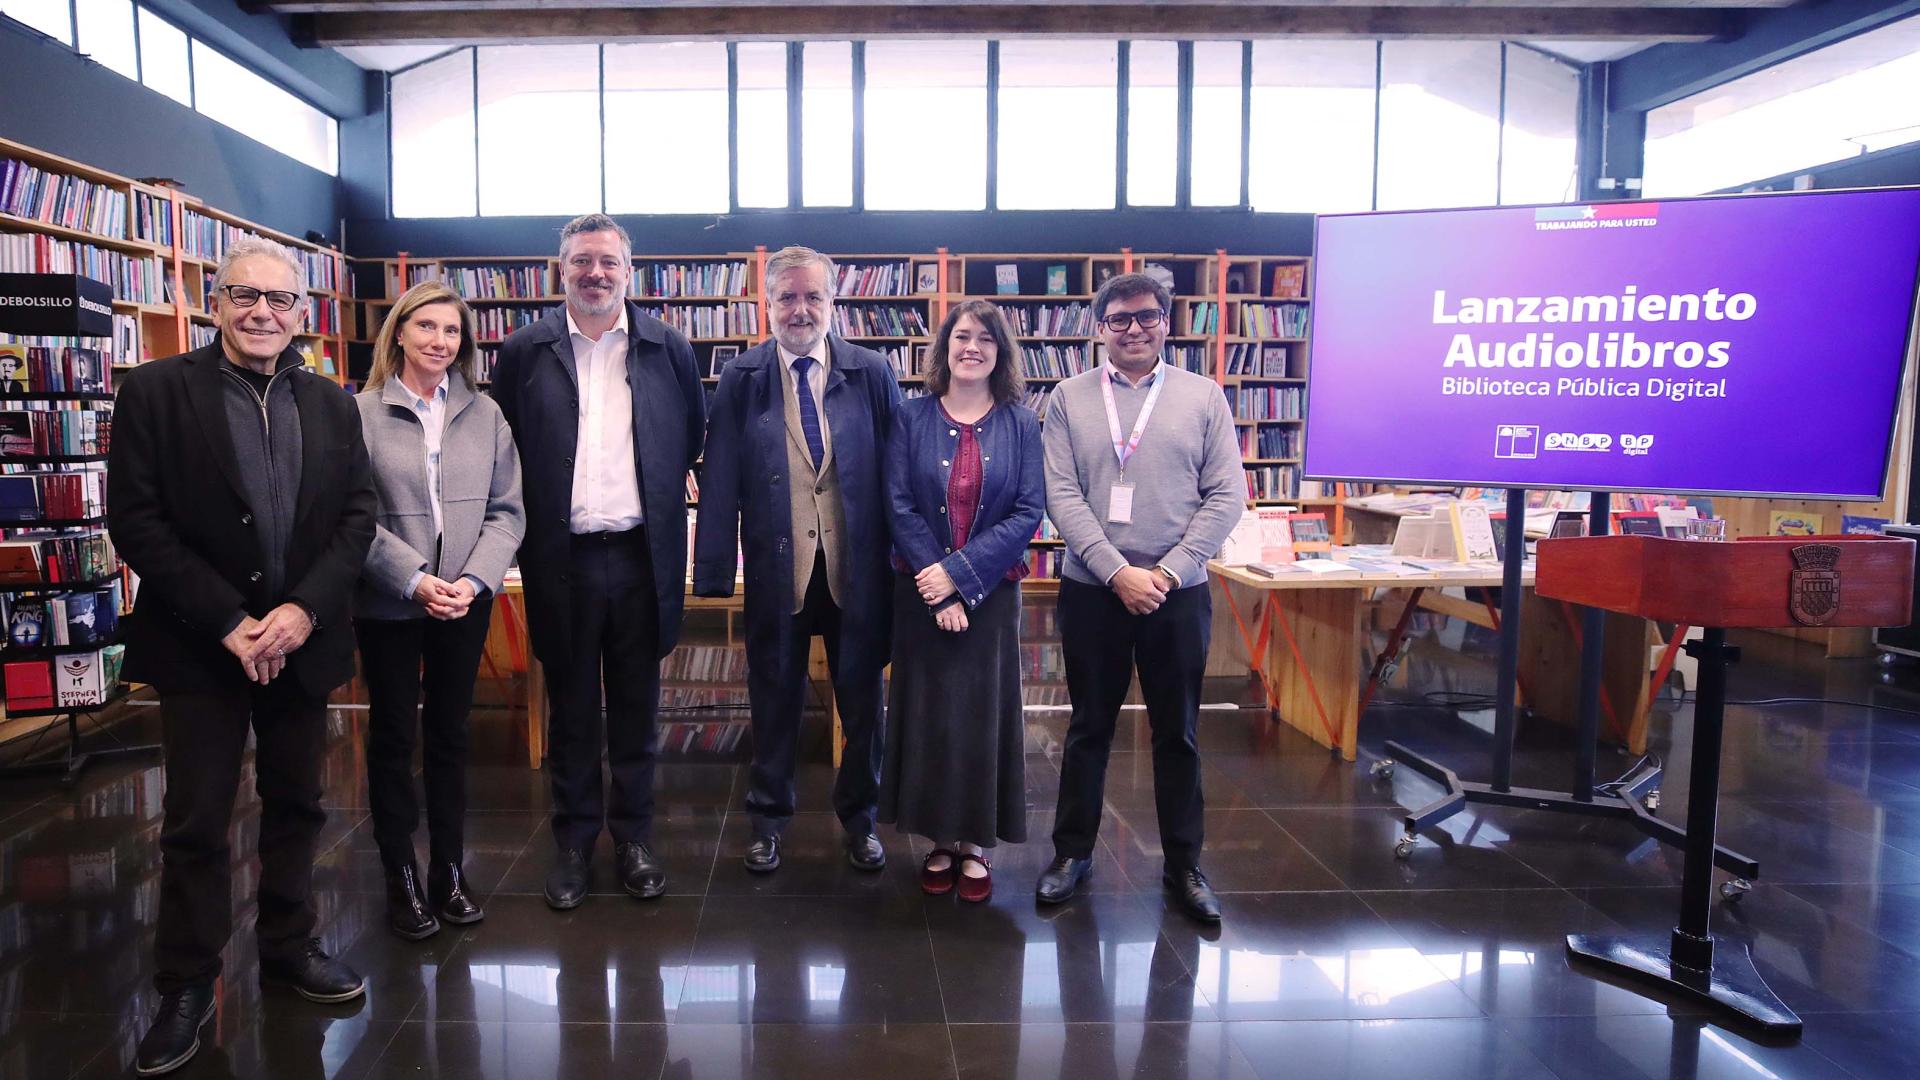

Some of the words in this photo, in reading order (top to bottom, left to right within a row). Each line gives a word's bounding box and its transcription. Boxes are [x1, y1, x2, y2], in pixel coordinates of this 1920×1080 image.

[1535, 221, 1598, 230] TRABAJANDO
[1599, 219, 1623, 228] PARA
[1625, 218, 1657, 227] USTED
[1432, 285, 1757, 324] Lanzamiento
[1443, 332, 1731, 369] Audiolibros
[1442, 377, 1551, 396] Biblioteca
[1556, 377, 1641, 397] Pública
[1646, 377, 1727, 402] Digital
[1548, 434, 1611, 447] SNBP
[1623, 448, 1649, 456] digital
[11, 610, 43, 624] KING
[73, 677, 84, 687] IT
[61, 690, 97, 699] STEPHEN
[63, 698, 97, 707] KING
